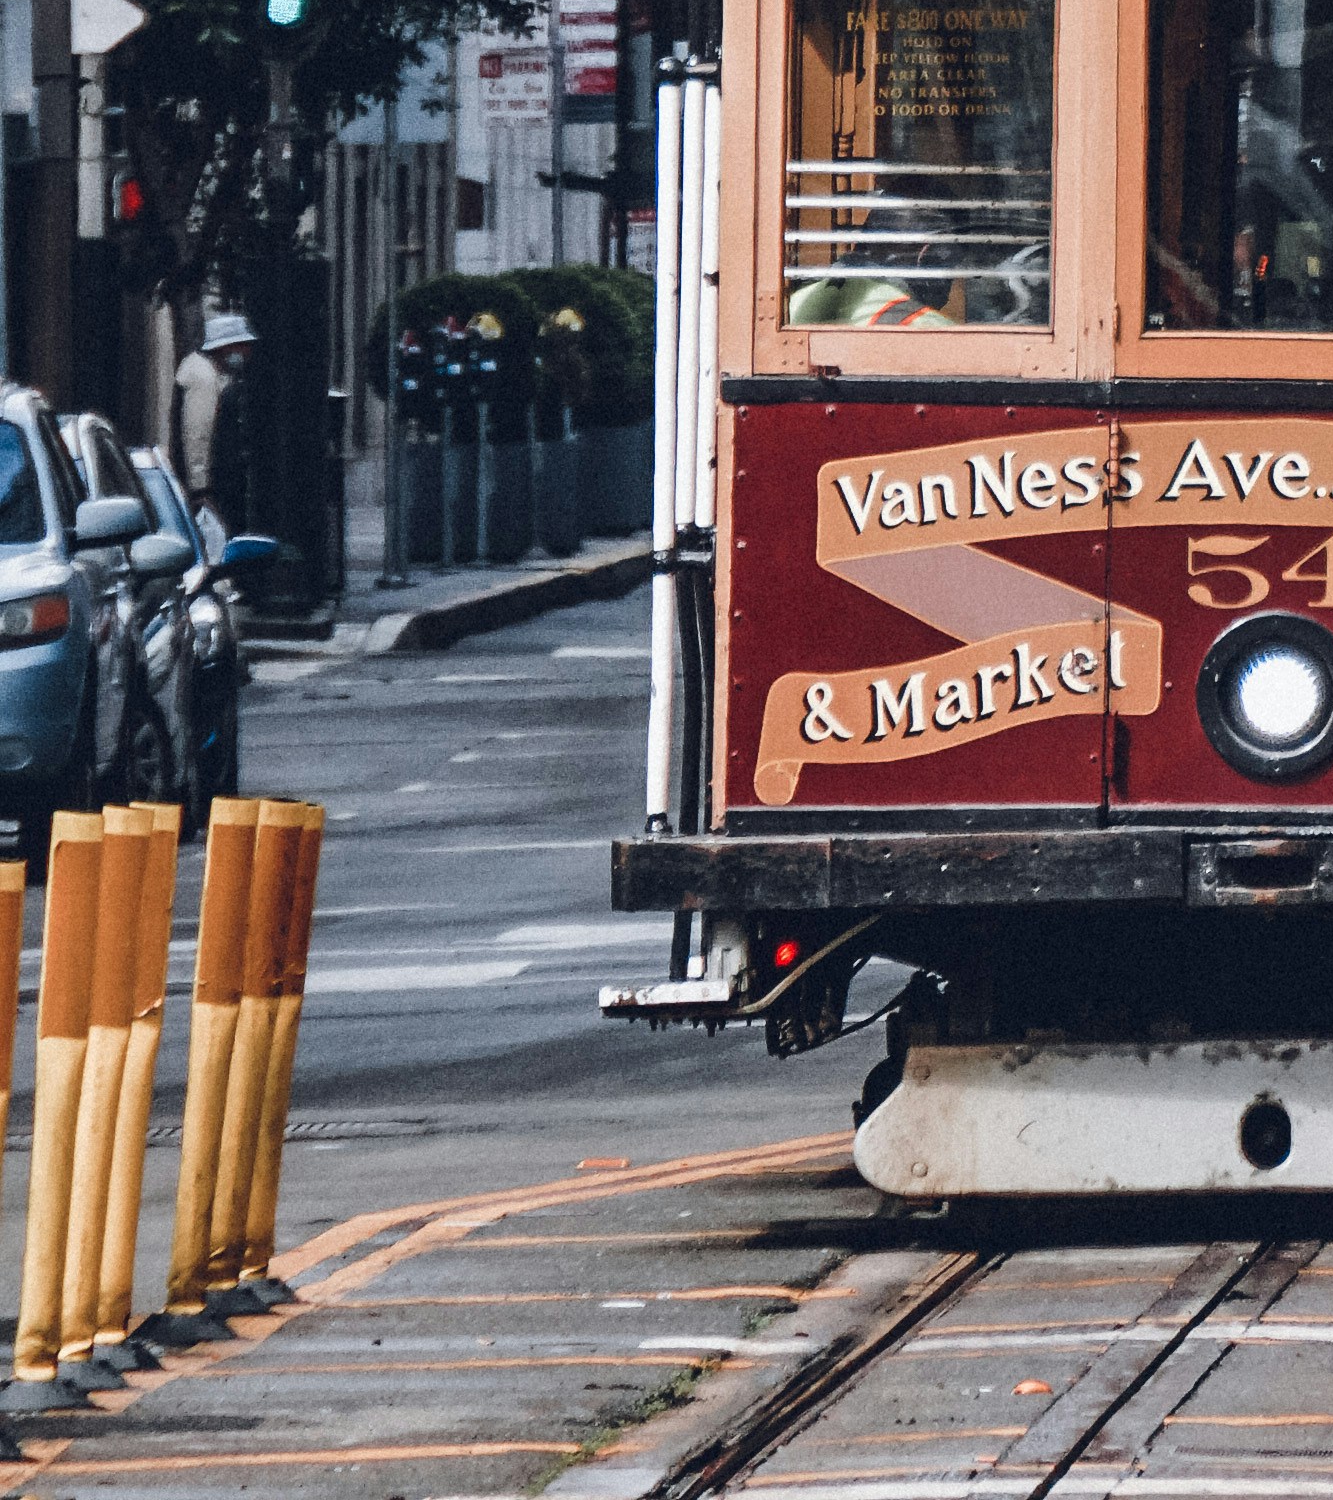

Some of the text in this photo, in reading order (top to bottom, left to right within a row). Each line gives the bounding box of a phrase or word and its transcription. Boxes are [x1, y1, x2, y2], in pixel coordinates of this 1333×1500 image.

[943, 8, 985, 31] ONE
[879, 86, 902, 99] NO
[938, 103, 961, 116] OR
[838, 468, 957, 540] Van
[966, 442, 1143, 523] Ness
[799, 680, 854, 750] &
[866, 624, 1128, 746] Market
